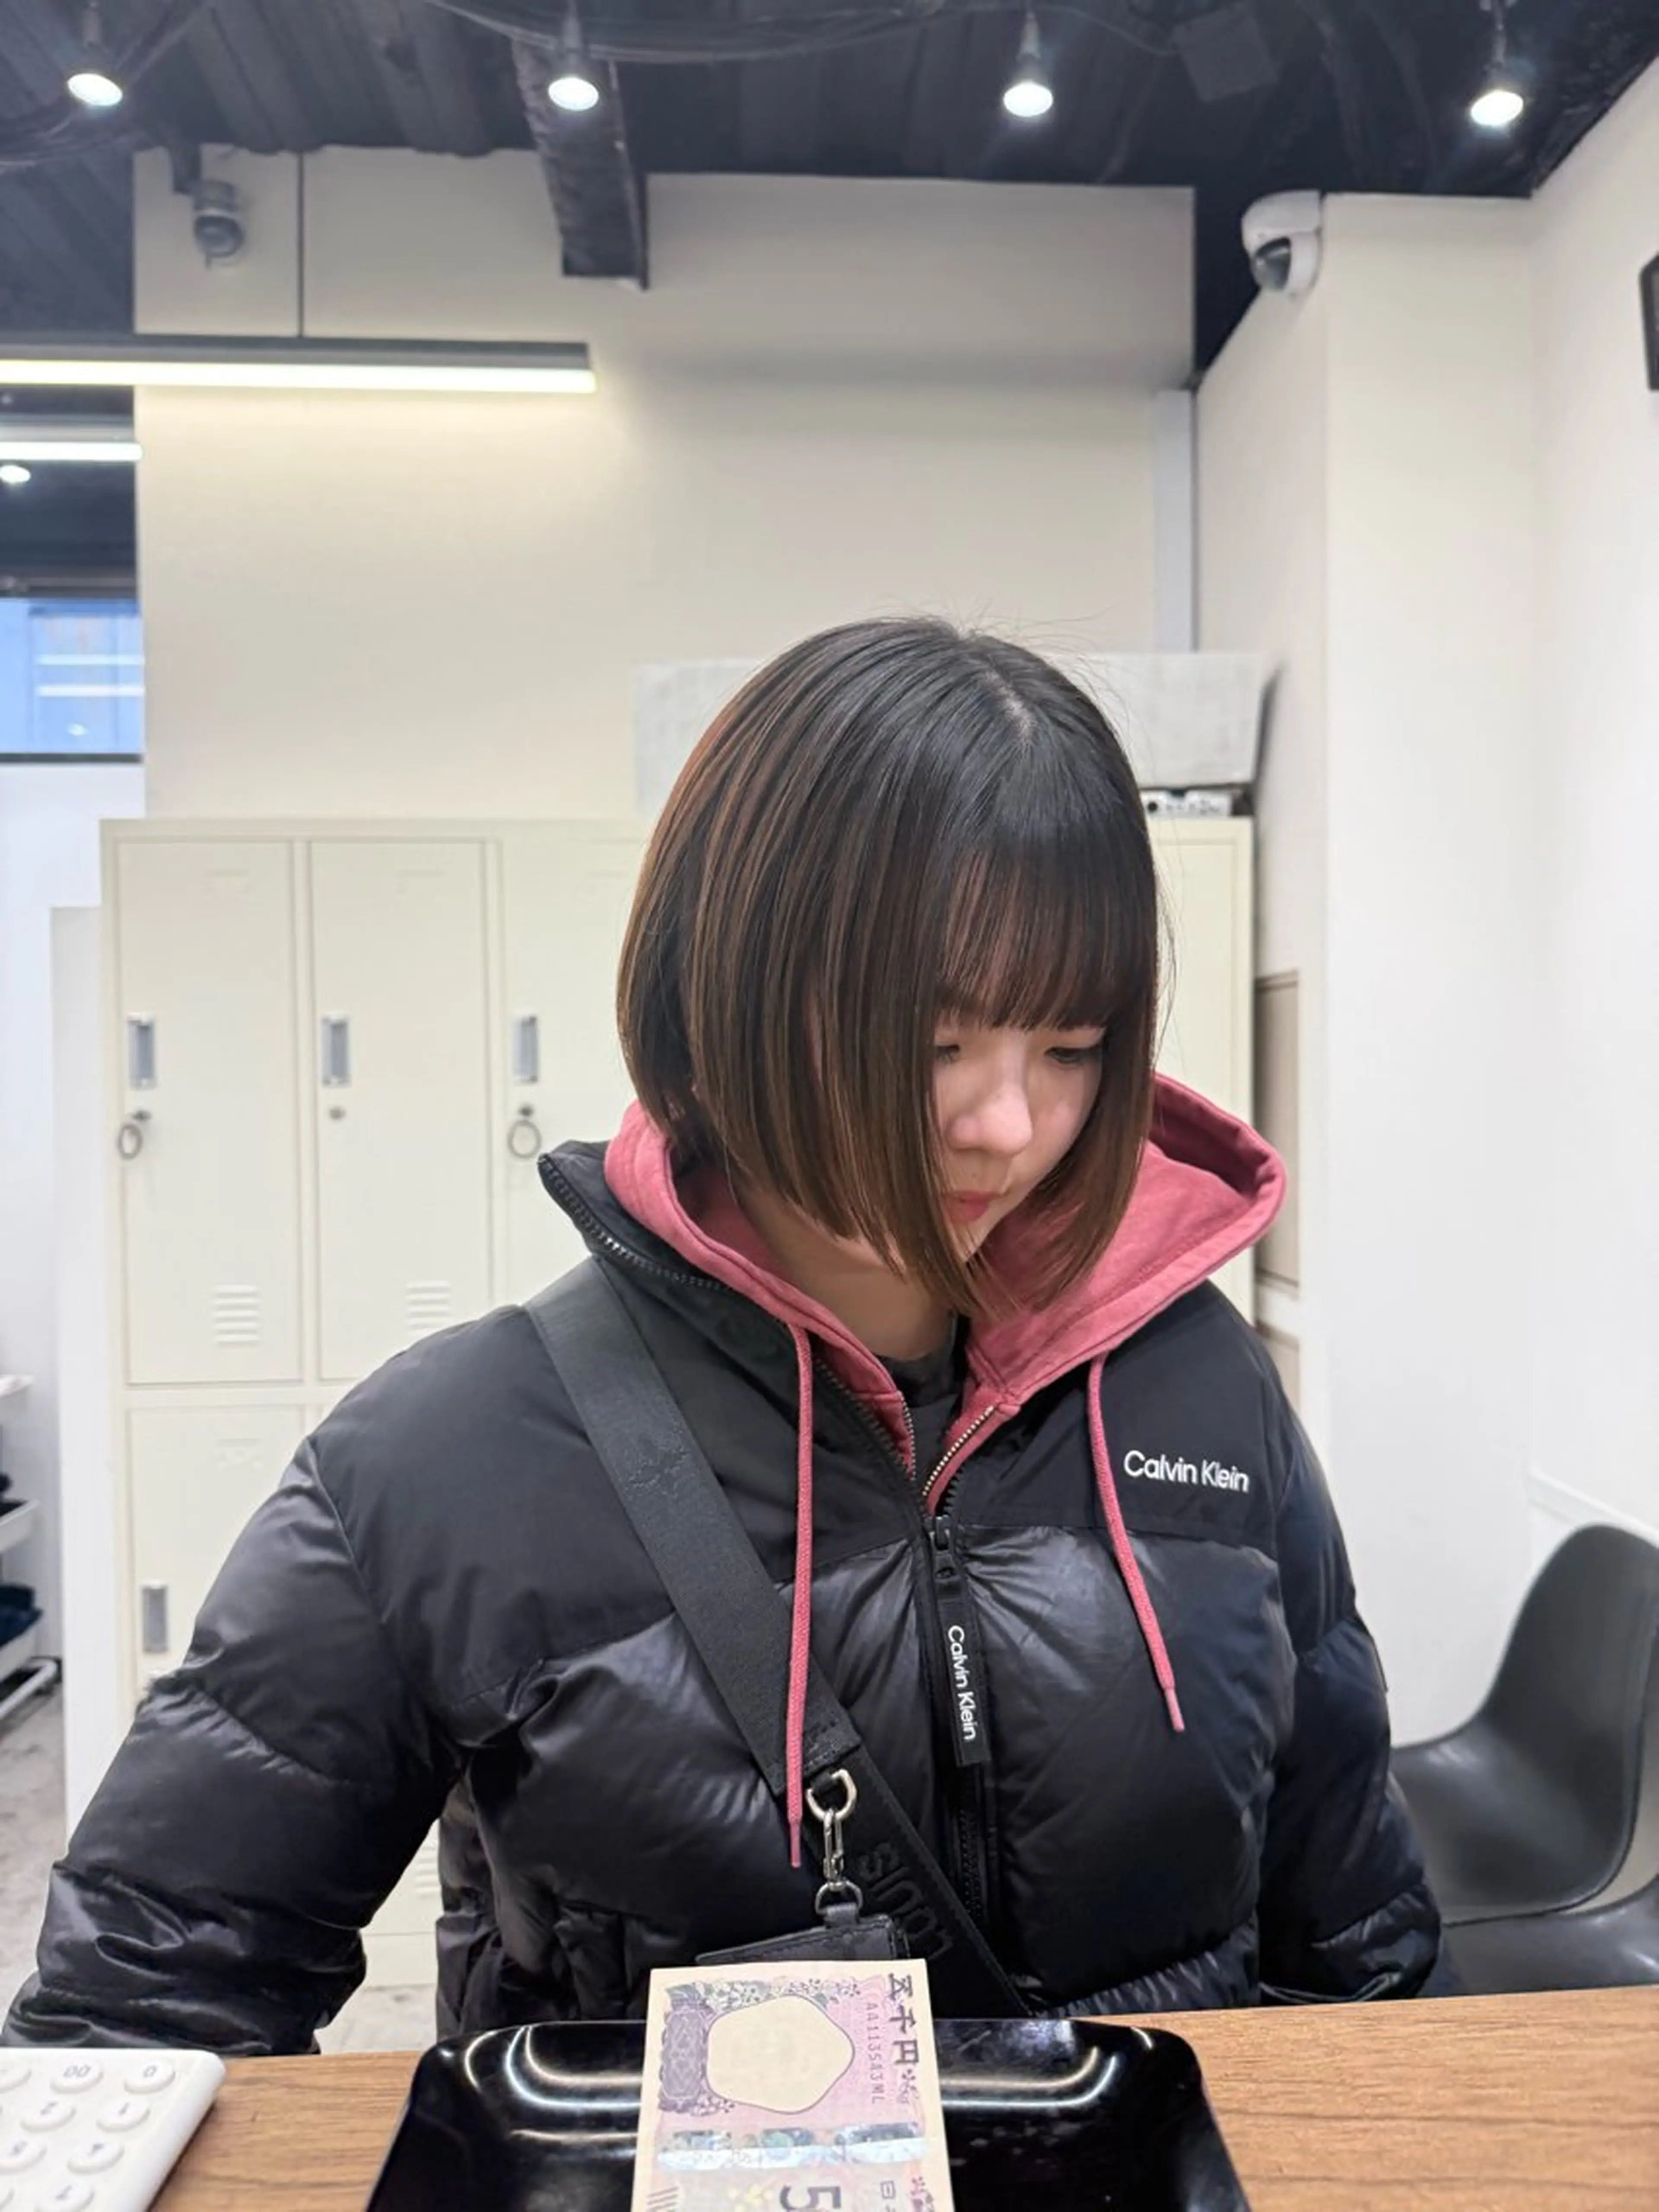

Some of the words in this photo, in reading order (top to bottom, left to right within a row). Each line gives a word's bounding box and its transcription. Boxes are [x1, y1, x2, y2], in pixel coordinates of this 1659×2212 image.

[1124, 1450, 1198, 1484] Calvin
[1201, 1459, 1250, 1493] Klein
[948, 1625, 969, 1688] Calvin
[957, 1691, 978, 1741] Klein
[888, 1973, 919, 2065] 五千円
